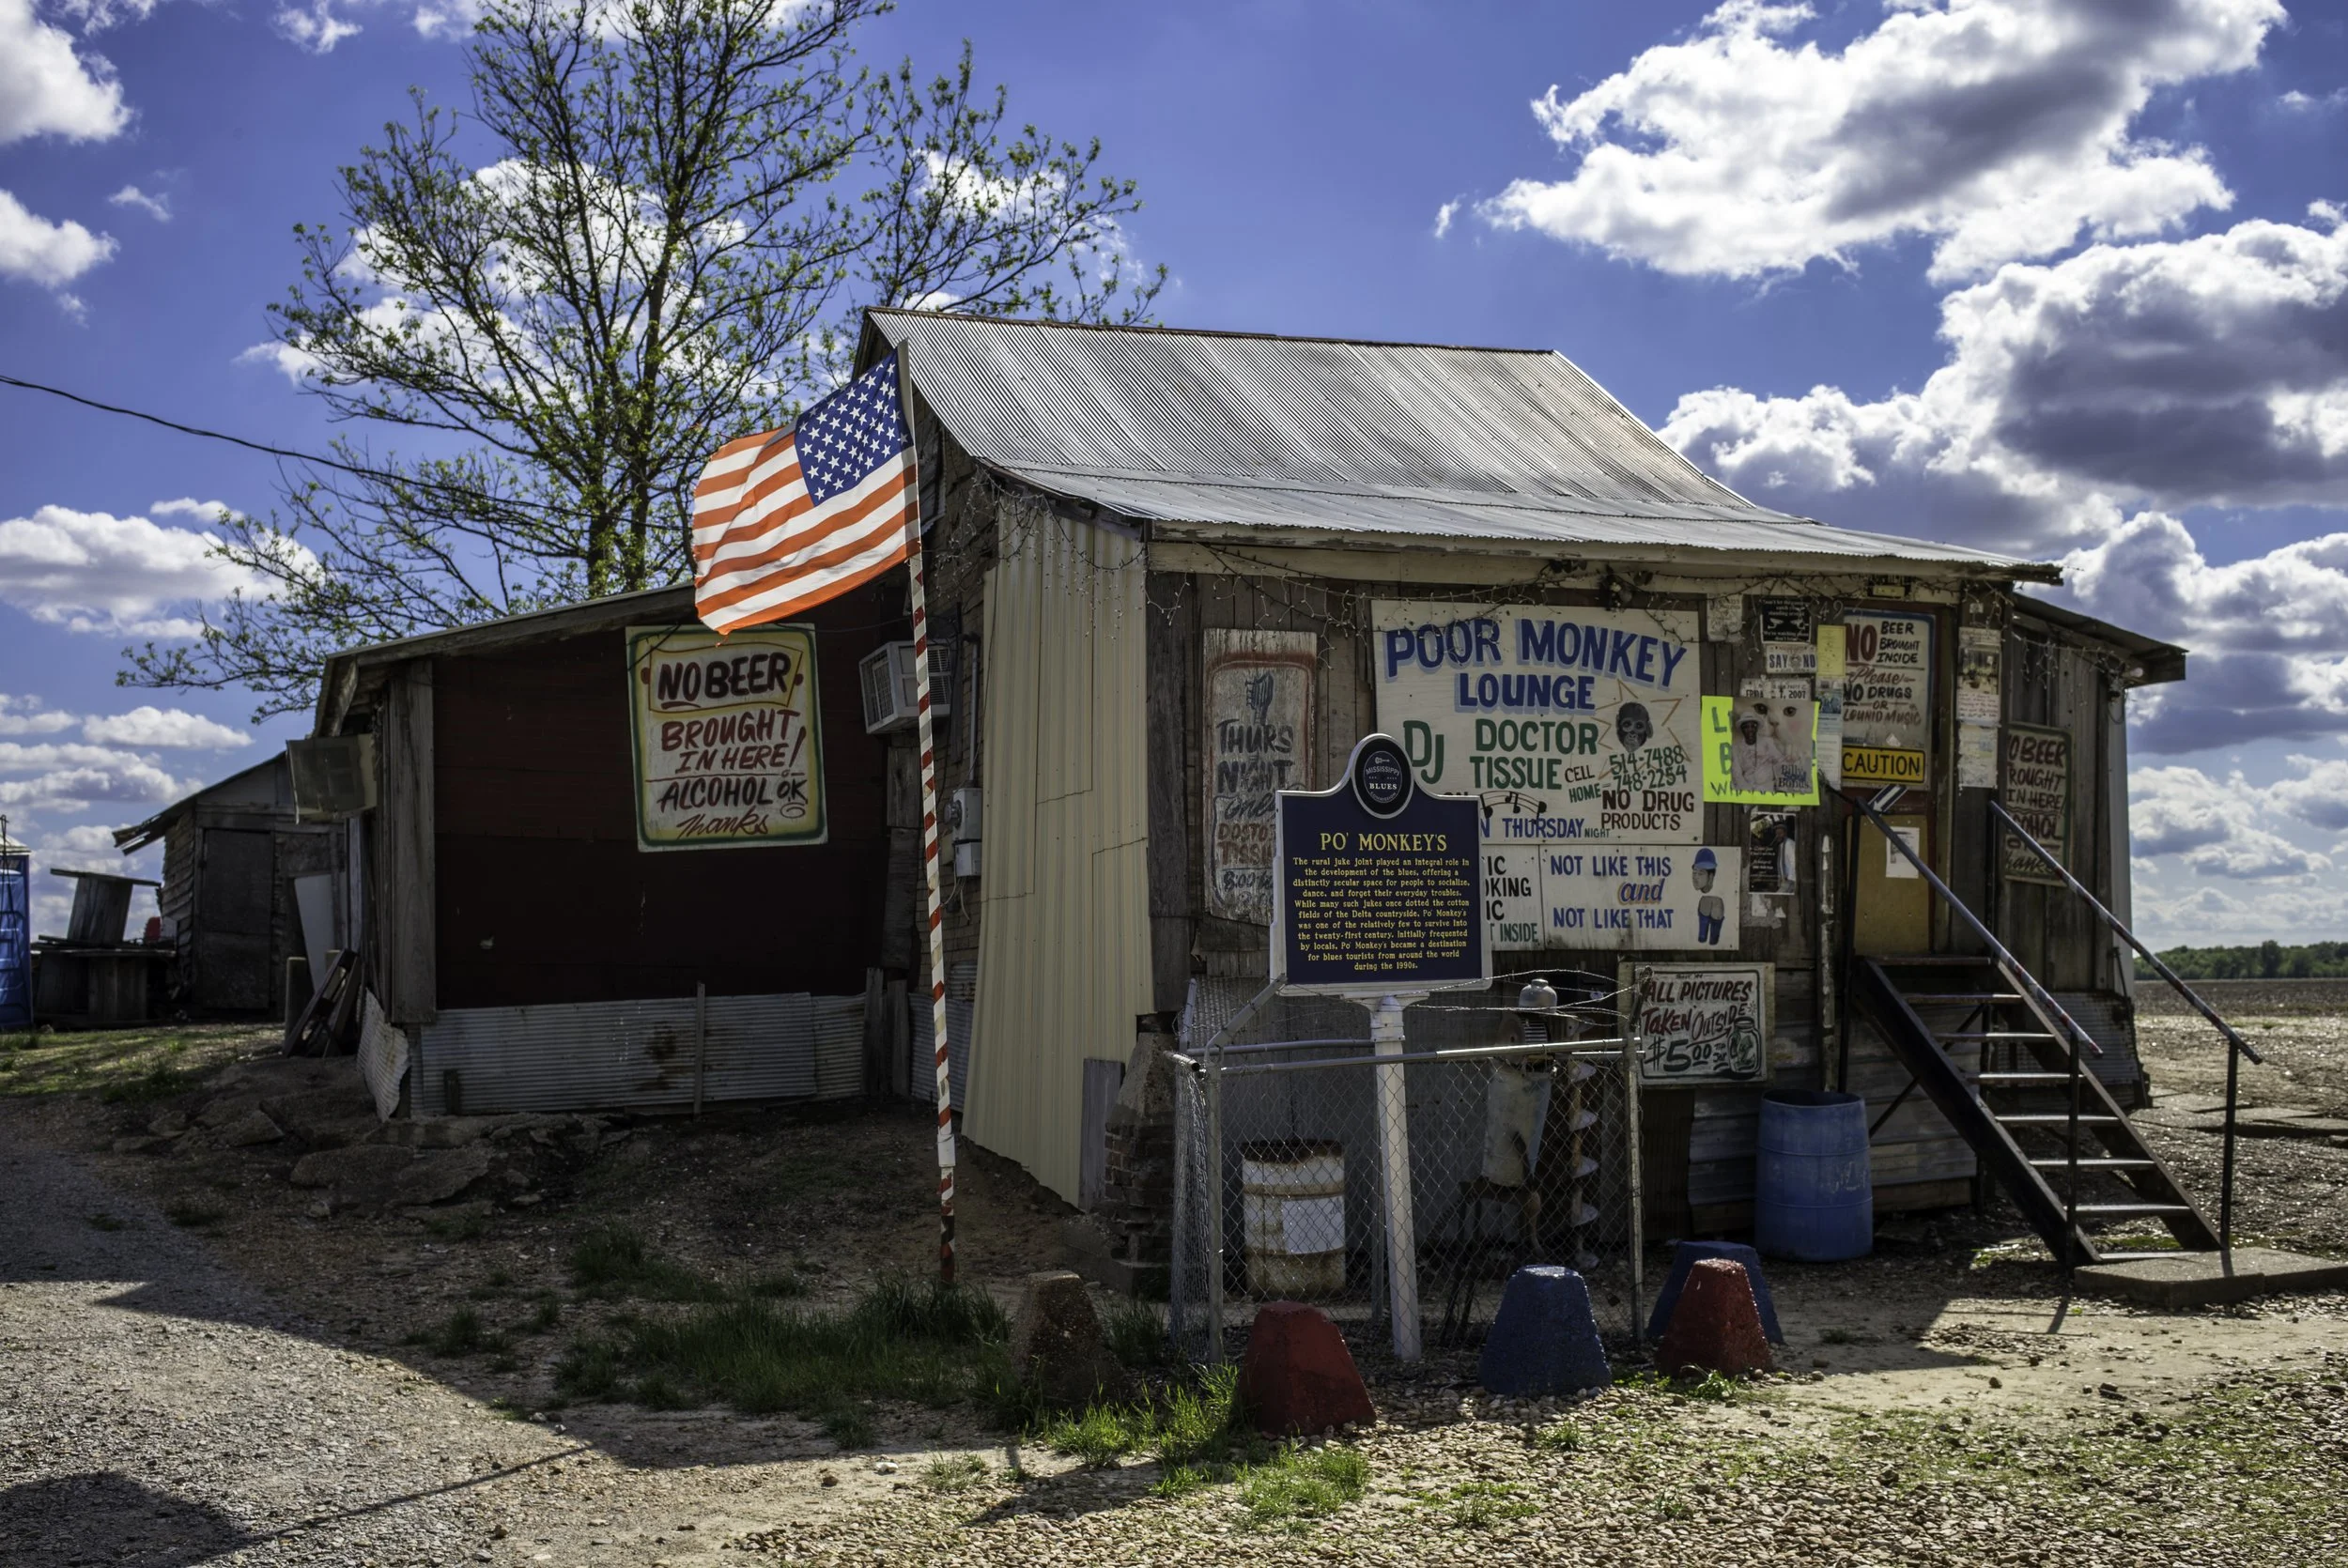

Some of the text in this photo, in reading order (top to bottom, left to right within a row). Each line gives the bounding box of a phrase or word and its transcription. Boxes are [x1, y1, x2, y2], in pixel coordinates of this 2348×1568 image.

[1881, 621, 1914, 635] BEER
[1846, 623, 1877, 661] NO
[1879, 638, 1920, 651] BROUGHT
[1383, 619, 1687, 691] POOR MONKEY
[1769, 654, 1815, 669] SAY NO
[1877, 652, 1918, 663] INSIDE
[657, 653, 792, 701] NO BEER
[1847, 667, 1904, 685] Please
[1455, 673, 1596, 715] LOUNGE
[1844, 684, 1912, 701] NO DRUGS
[1873, 700, 1889, 709] OR
[661, 709, 800, 751] BROUGHT
[1215, 719, 1293, 754] THURS
[675, 727, 806, 774] IN HERE!
[1403, 718, 1599, 785] DJ DOCTOR
[2020, 736, 2066, 768] BEER
[1609, 746, 1685, 776] 514-7488
[1842, 752, 1921, 776] CAUTION
[1470, 756, 1563, 790] TISSUE
[1565, 765, 1595, 783] CELL
[1613, 764, 1687, 794] 748-2254
[2007, 767, 2066, 792] ROUGHT
[657, 776, 809, 813] ALCOHOL OK
[1568, 783, 1602, 803] HOME
[1602, 789, 1630, 810] NO
[1643, 790, 1694, 812] DRUG
[2006, 789, 2027, 802] IN
[676, 805, 769, 838] Thanks
[1503, 818, 1584, 838] THURSDAY
[1584, 828, 1611, 838] NIGHT
[1600, 812, 1681, 831] PRODUCTS
[1320, 832, 1447, 852] PO' MONKEY'S
[1311, 857, 1330, 866] rural
[1335, 857, 1351, 867] juke
[1354, 857, 1372, 867] joint
[1376, 858, 1399, 867] played
[1551, 855, 1672, 877] NOT LIKE THIS
[1292, 879, 1330, 887] distinctly
[1400, 879, 1424, 887] people
[1321, 869, 1367, 877] development
[1422, 869, 1451, 877] offering
[1348, 889, 1371, 898] forget
[1396, 889, 1428, 898] everyday
[1618, 879, 1665, 904] and
[1352, 910, 1371, 918] Delta
[1436, 908, 1467, 917] Monkey's
[1363, 899, 1383, 909] jukes
[1360, 920, 1395, 929] relatively
[1553, 908, 1674, 929] NOT LIKE THAT
[1500, 922, 1538, 942] INSIDE
[1300, 943, 1310, 951] by
[1355, 941, 1386, 949] Monkey's
[1307, 953, 1321, 961] for
[1346, 952, 1374, 961] tourists
[1354, 962, 1378, 971] during
[1645, 980, 1753, 1003] ALL PICTURES
